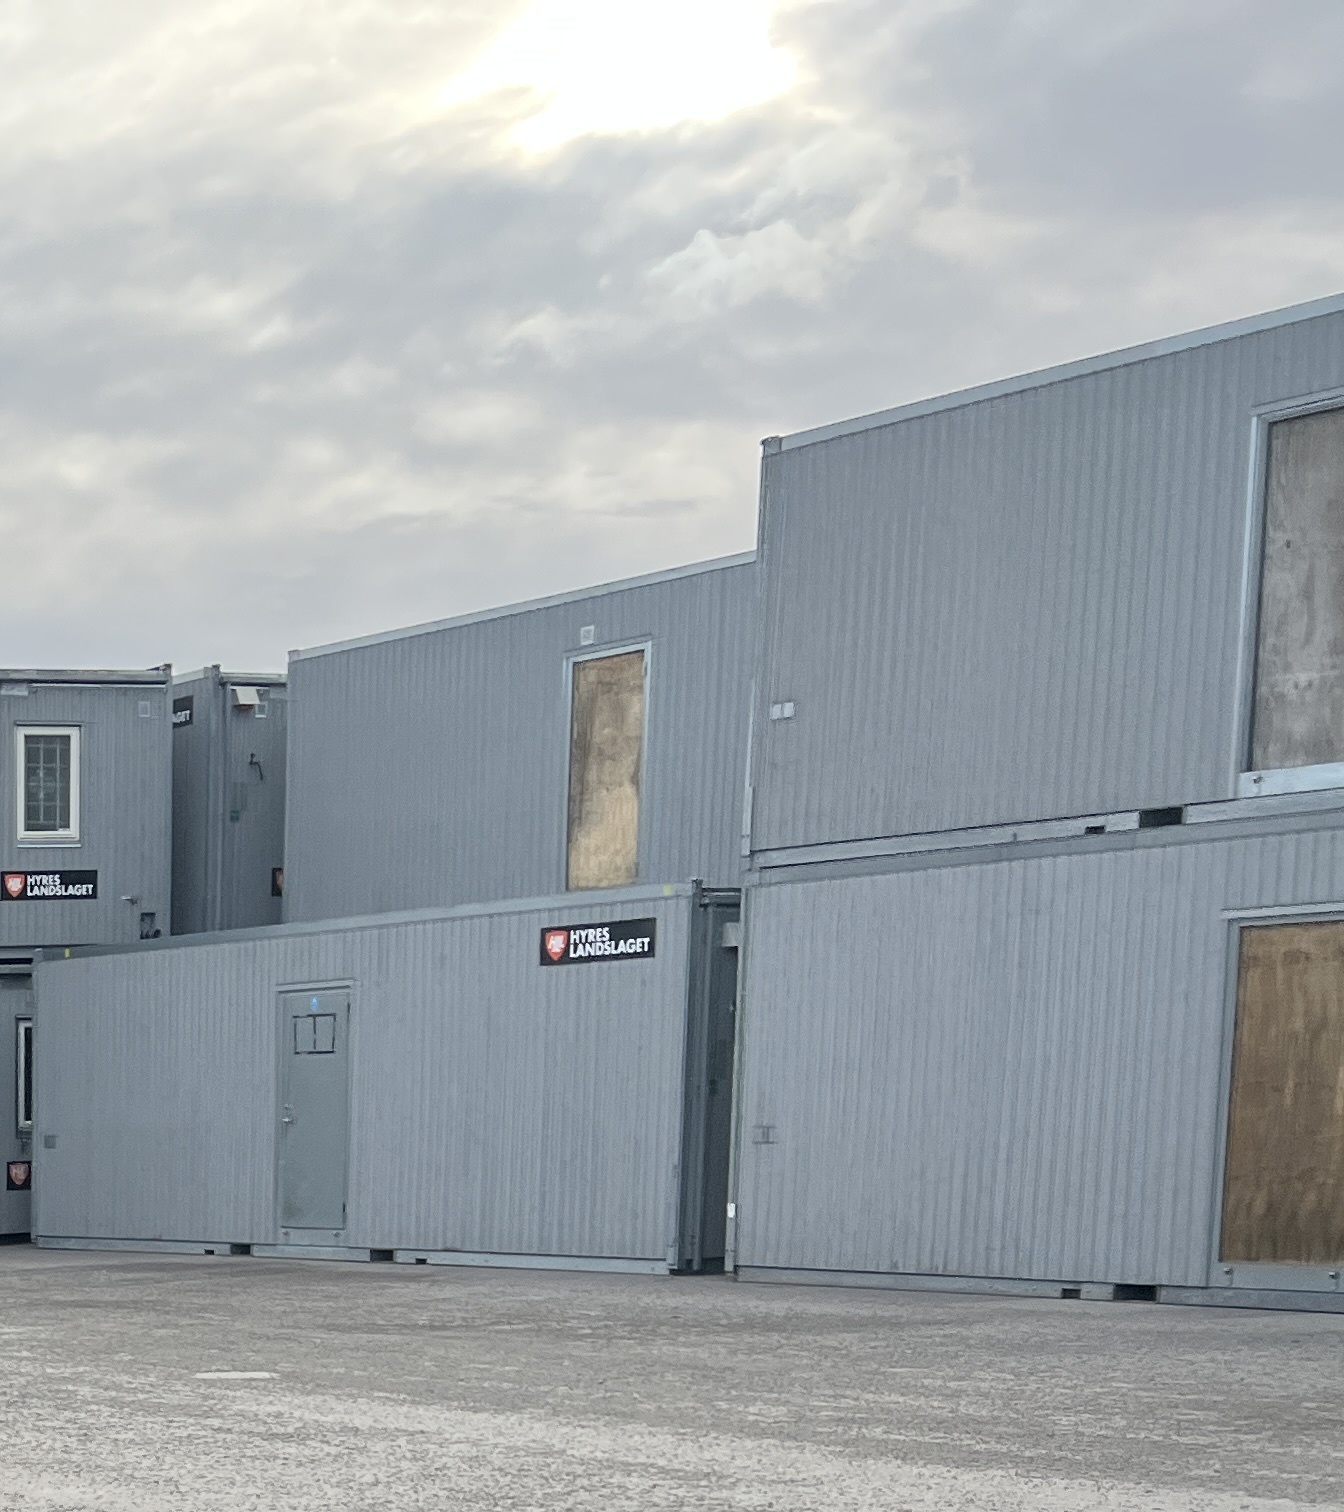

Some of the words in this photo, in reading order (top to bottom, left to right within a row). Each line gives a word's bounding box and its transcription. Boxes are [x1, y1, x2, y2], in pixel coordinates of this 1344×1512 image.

[26, 874, 61, 886] HYRES
[26, 884, 94, 896] LANDSLAGET
[569, 927, 610, 944] HYRES
[569, 937, 650, 958] LANDSLAGET
